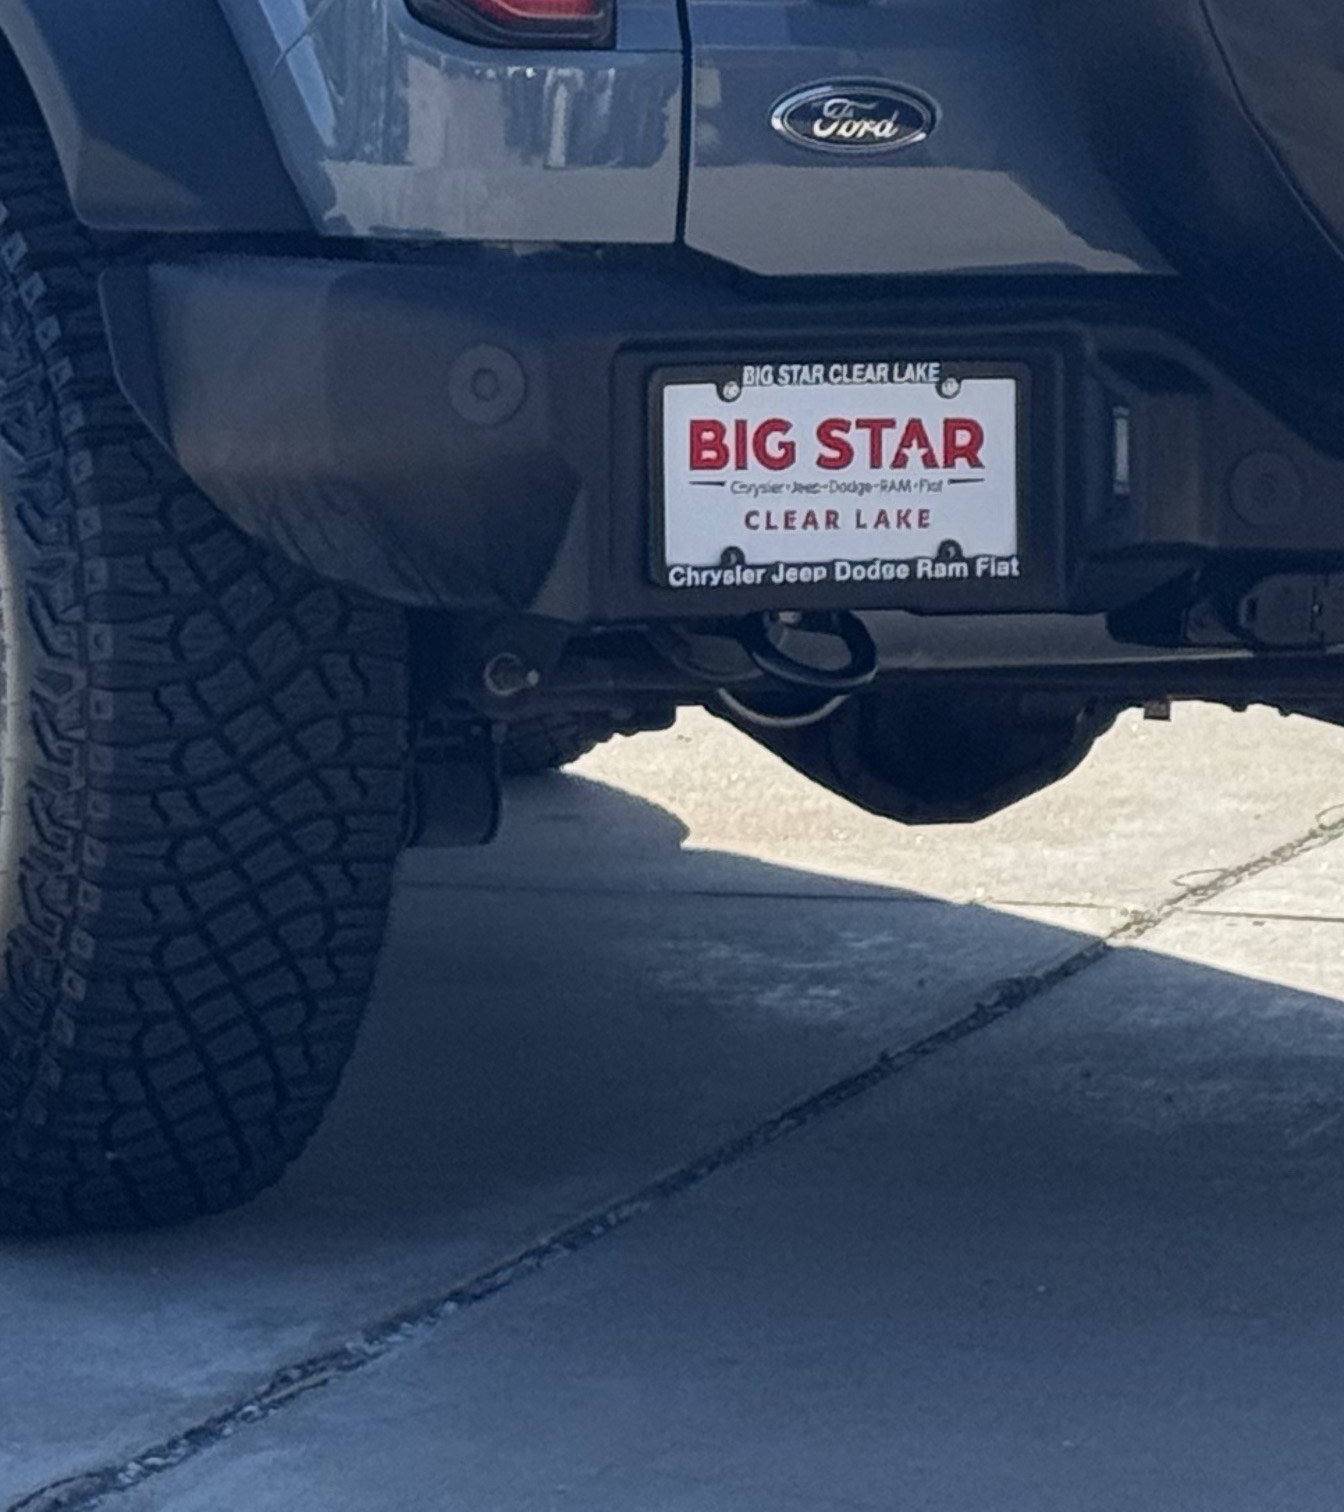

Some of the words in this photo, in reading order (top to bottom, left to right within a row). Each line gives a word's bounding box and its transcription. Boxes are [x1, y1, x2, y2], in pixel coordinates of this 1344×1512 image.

[812, 97, 900, 138] Ford
[742, 365, 774, 385] BIG
[777, 364, 825, 384] STAR
[828, 363, 889, 383] CLEAR
[892, 362, 941, 382] LAKE
[689, 418, 797, 471] BIG
[815, 417, 986, 470] STAR
[744, 509, 840, 531] CLEAR
[855, 508, 931, 529] LAKE
[668, 565, 766, 588] Chrysler
[771, 562, 827, 584] Jeep
[834, 560, 910, 583] Dodge
[916, 557, 969, 579] Ram
[975, 555, 1020, 578] Fiat
